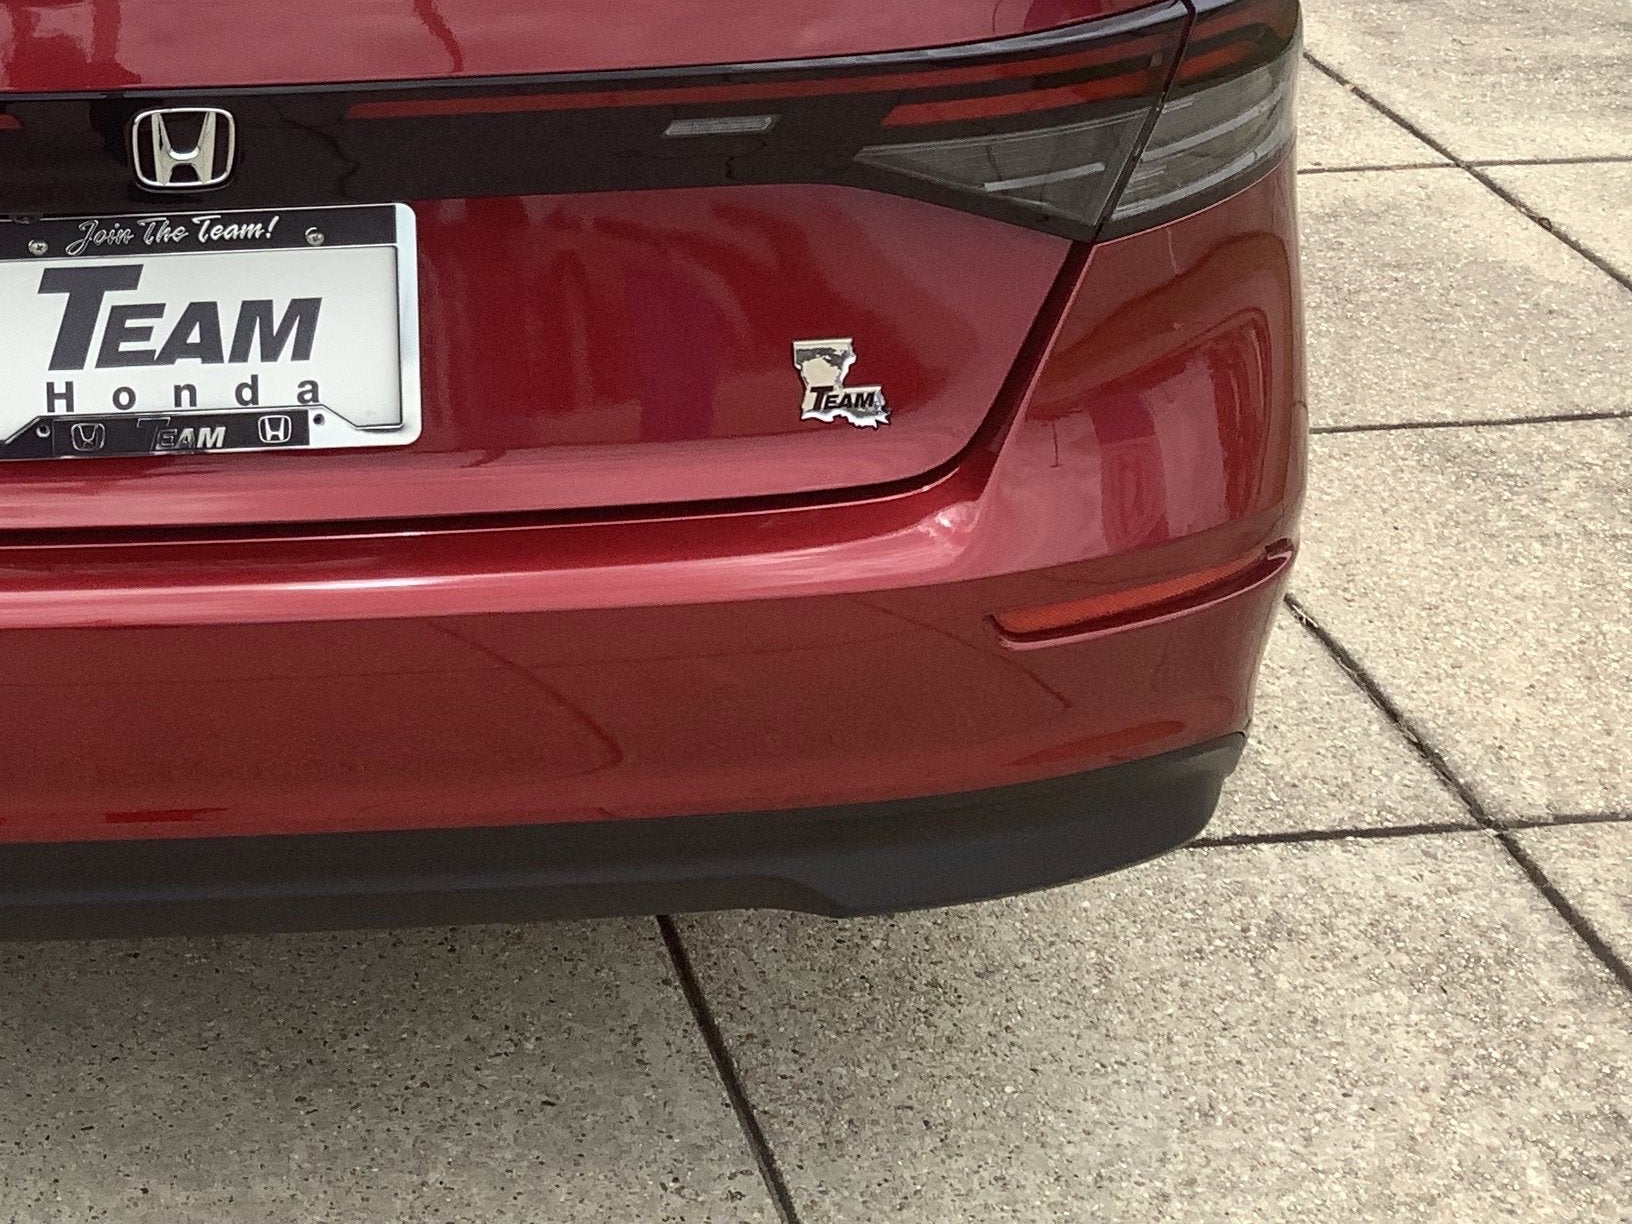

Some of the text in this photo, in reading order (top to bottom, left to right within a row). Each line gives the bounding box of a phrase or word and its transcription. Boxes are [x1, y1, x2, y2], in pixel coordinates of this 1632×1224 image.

[65, 215, 280, 256] Join The Team!
[37, 264, 322, 371] TEAM
[46, 374, 320, 414] Honda
[809, 385, 876, 411] TEAM
